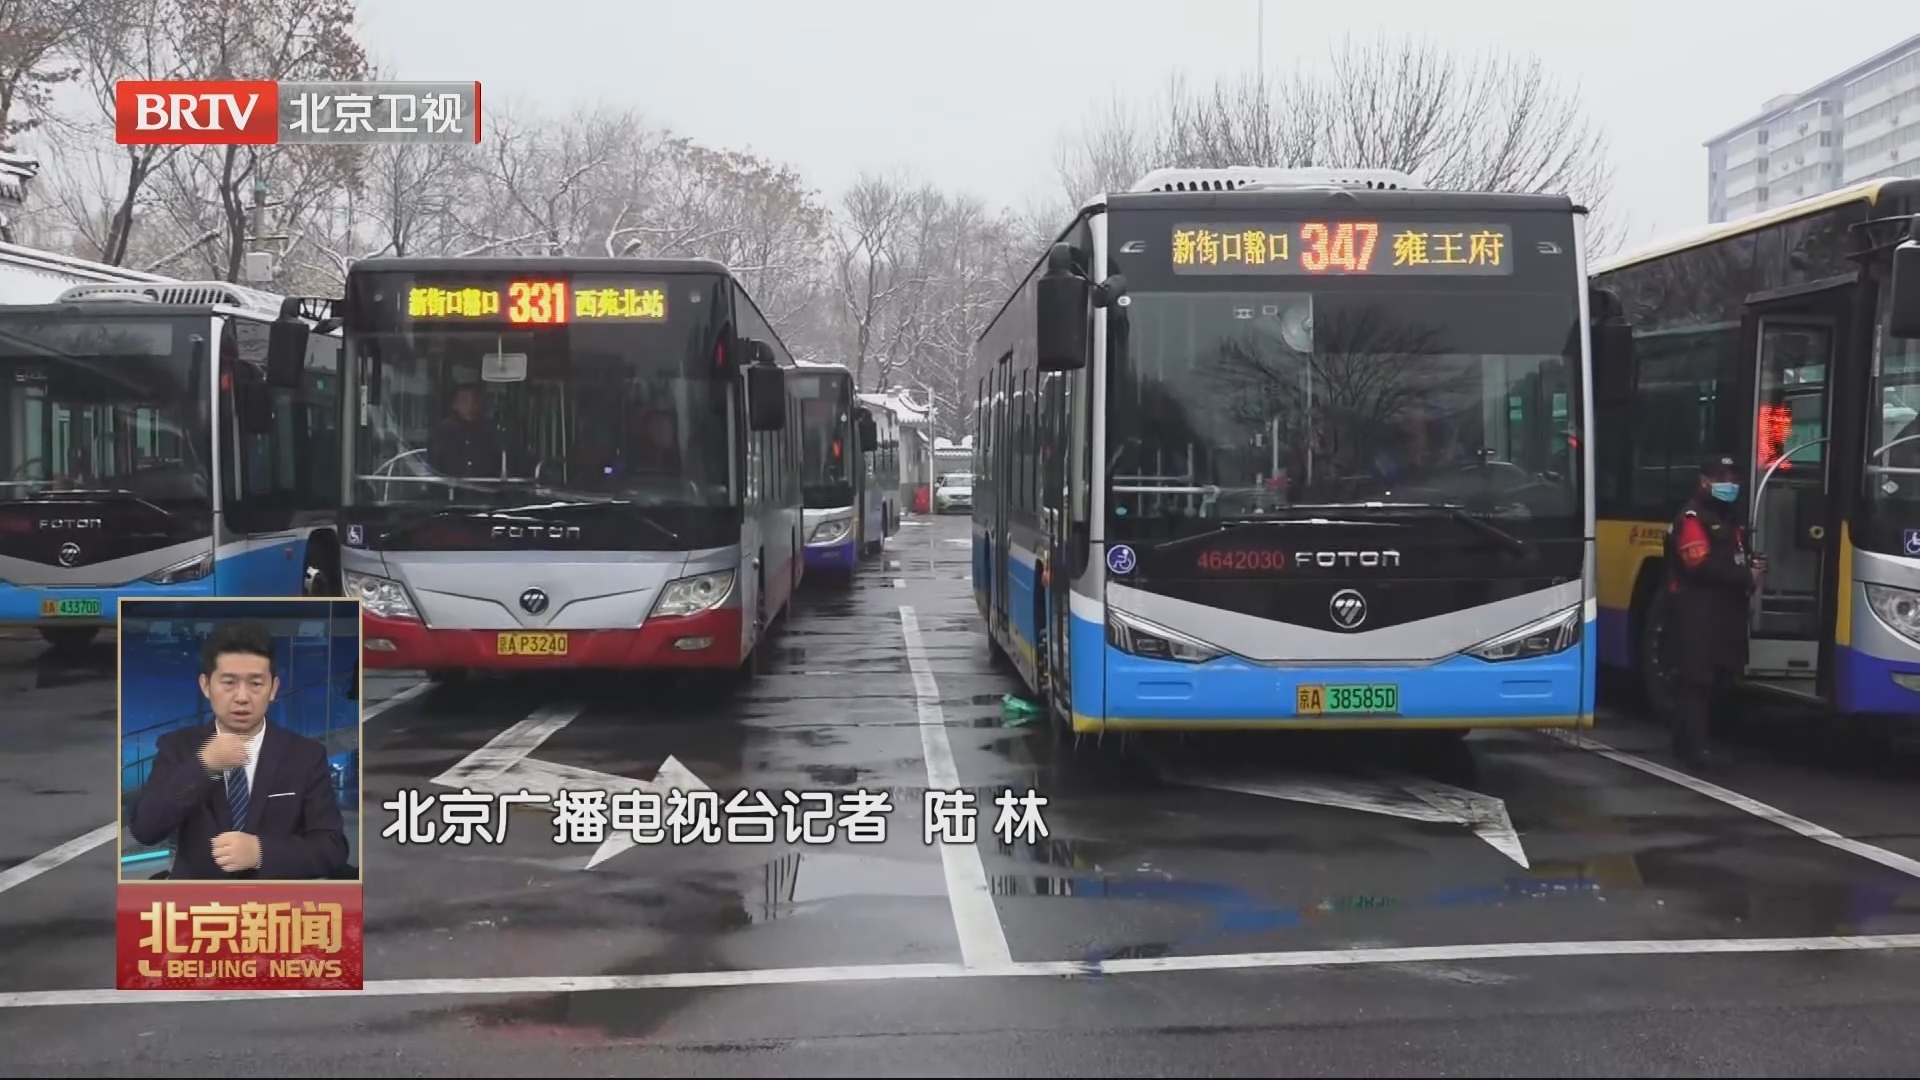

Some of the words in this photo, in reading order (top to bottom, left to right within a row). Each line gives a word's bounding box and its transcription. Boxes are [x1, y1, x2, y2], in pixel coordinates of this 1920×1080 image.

[1173, 229, 1289, 265] 新街口豁口
[1301, 223, 1379, 271] 347
[1392, 231, 1505, 266] 雍王府
[508, 282, 566, 323] 331
[574, 290, 665, 317] 西苑北站
[39, 519, 102, 529] FOTON
[491, 526, 580, 538] FOTON
[1197, 551, 1285, 569] 4642030
[1295, 551, 1400, 567] FOTON
[42, 600, 99, 614] A43370D
